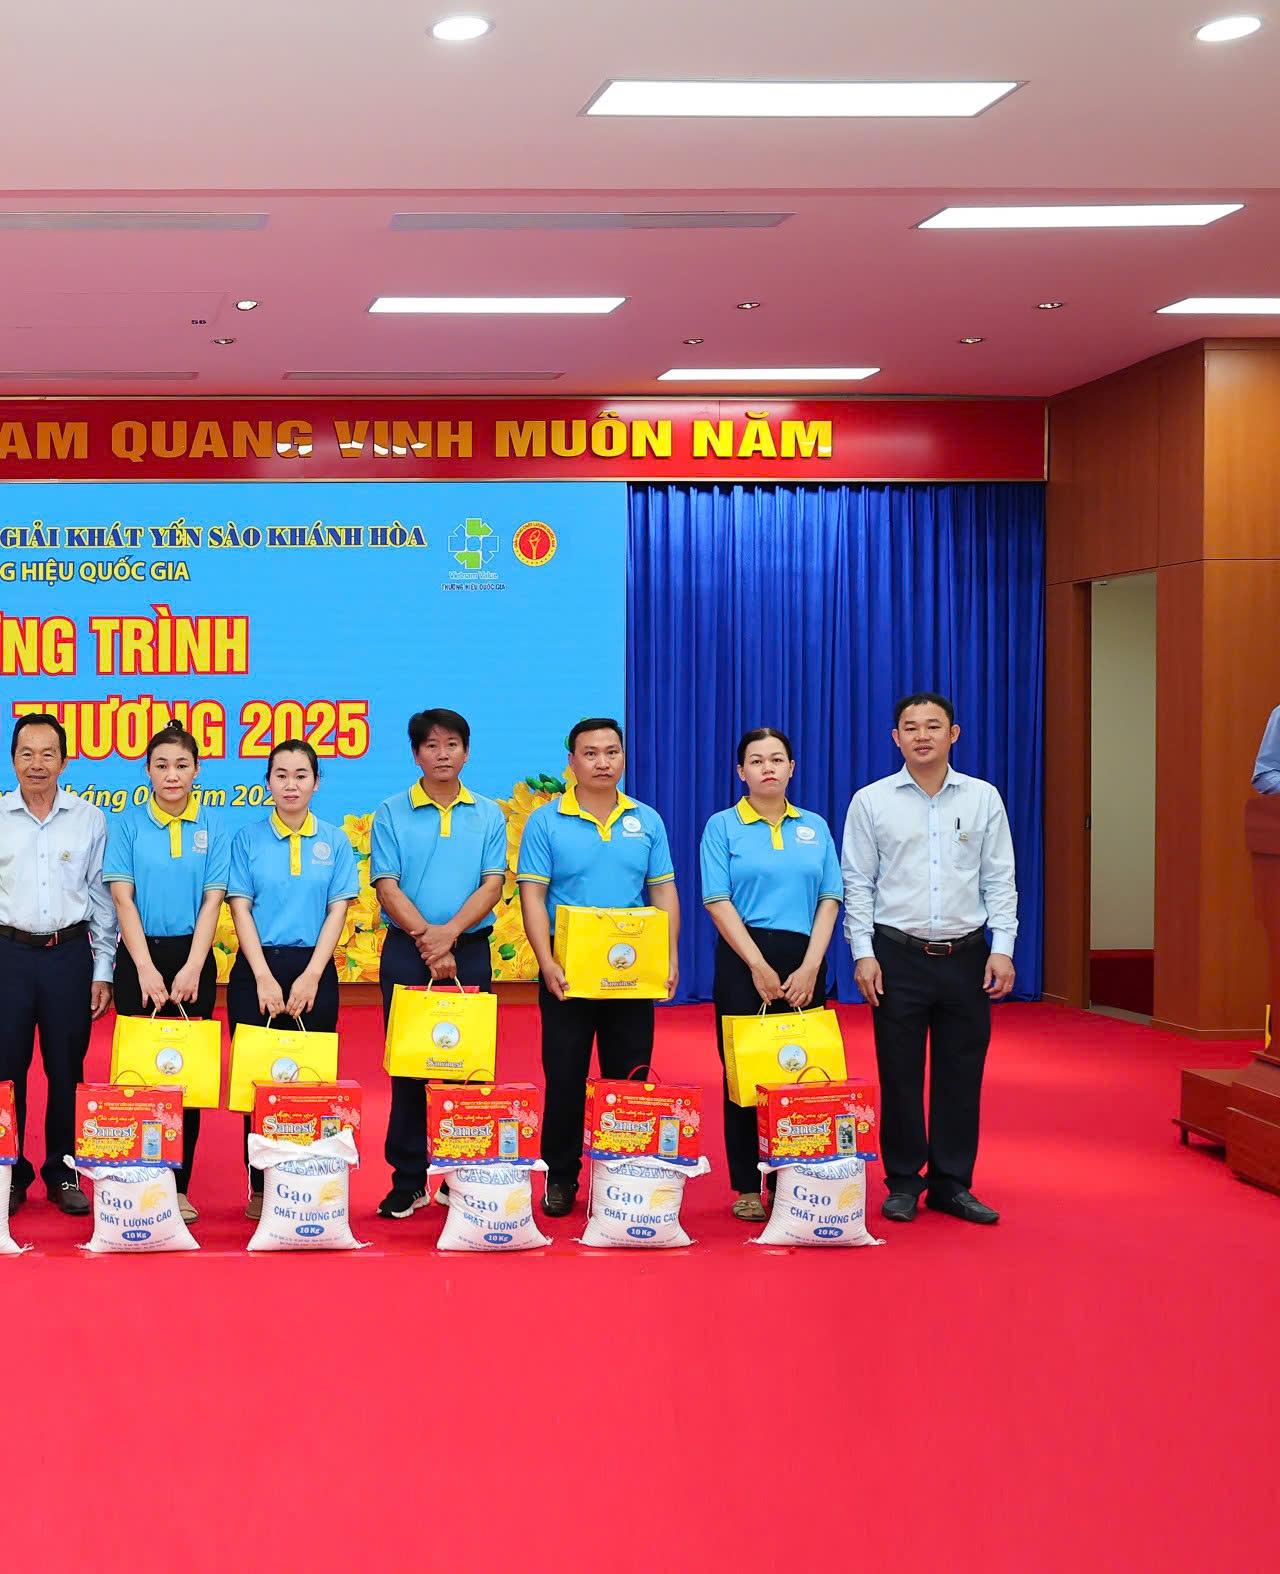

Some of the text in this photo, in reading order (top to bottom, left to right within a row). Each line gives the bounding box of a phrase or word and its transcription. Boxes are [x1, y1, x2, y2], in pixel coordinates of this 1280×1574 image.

[111, 420, 313, 462] QUANG
[334, 420, 473, 459] VINH
[495, 410, 672, 459] MUÔN
[693, 410, 833, 460] NĂM
[0, 520, 60, 549] GIẢI
[65, 521, 144, 548] KHÁT
[149, 518, 202, 548] YẾN
[208, 521, 261, 548] SÀO
[266, 521, 363, 548] KHÁNH
[368, 520, 427, 548] HÒA
[20, 556, 74, 586] HIỆU
[78, 555, 146, 583] QUỐC
[149, 561, 191, 581] GIA
[88, 603, 249, 676] TRÌNH
[239, 700, 370, 759] 2025
[83, 1118, 138, 1138] Sanest
[263, 1114, 317, 1135] Sanest
[440, 1116, 494, 1138] Sanest
[601, 1110, 656, 1133] Sanest
[777, 1116, 831, 1137] Sanest
[101, 1191, 132, 1210] Gạo
[277, 1184, 312, 1204] Gạo
[607, 1186, 643, 1205] Gạo
[794, 1186, 831, 1207] Gạo
[123, 1217, 154, 1229] LƯỢNG
[157, 1210, 172, 1222] CAO
[274, 1206, 344, 1223] CHẤT LƯỢNG CAO
[605, 1208, 627, 1221] CHẤT
[631, 1214, 661, 1226] LƯỢNG
[791, 1207, 815, 1221] CHẤT
[819, 1215, 848, 1226] LƯỢNG
[488, 1221, 517, 1232] LƯỢNG
